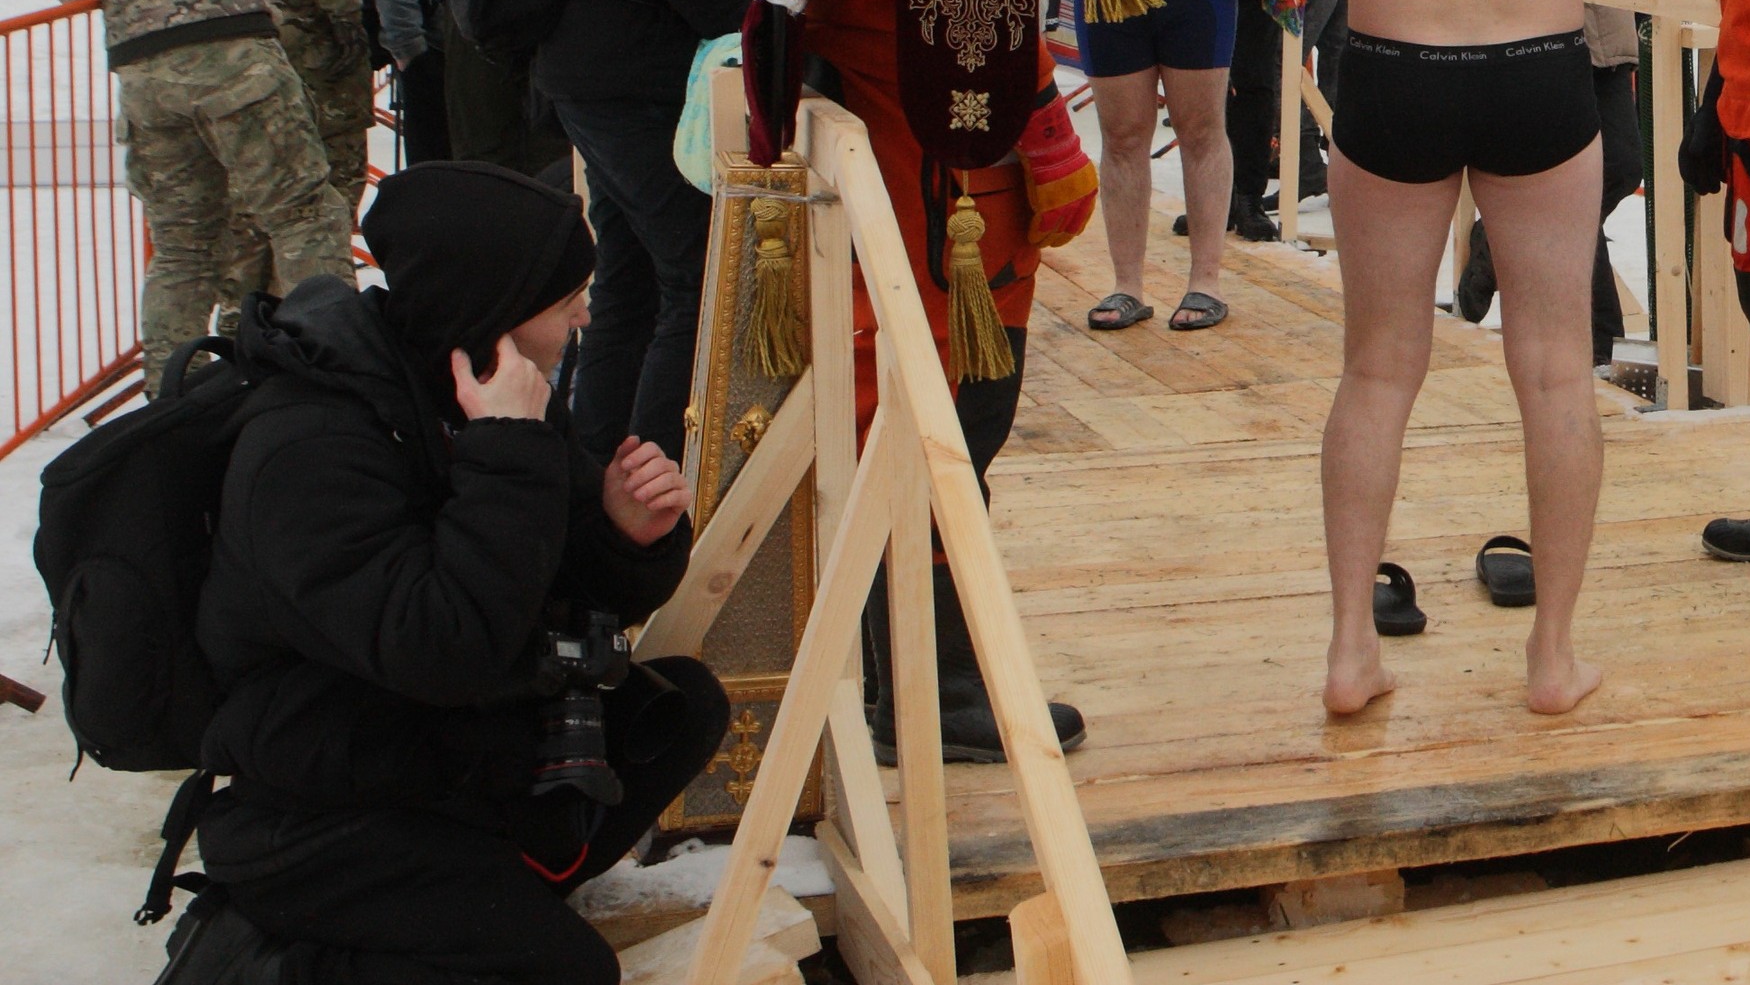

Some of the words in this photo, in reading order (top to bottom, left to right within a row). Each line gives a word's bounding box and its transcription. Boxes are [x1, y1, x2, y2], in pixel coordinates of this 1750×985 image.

[1349, 36, 1374, 52] Calvin
[1375, 44, 1401, 57] Klein
[1505, 44, 1542, 57] Calvin
[1419, 50, 1458, 61] Calvin
[1460, 51, 1488, 62] Klein
